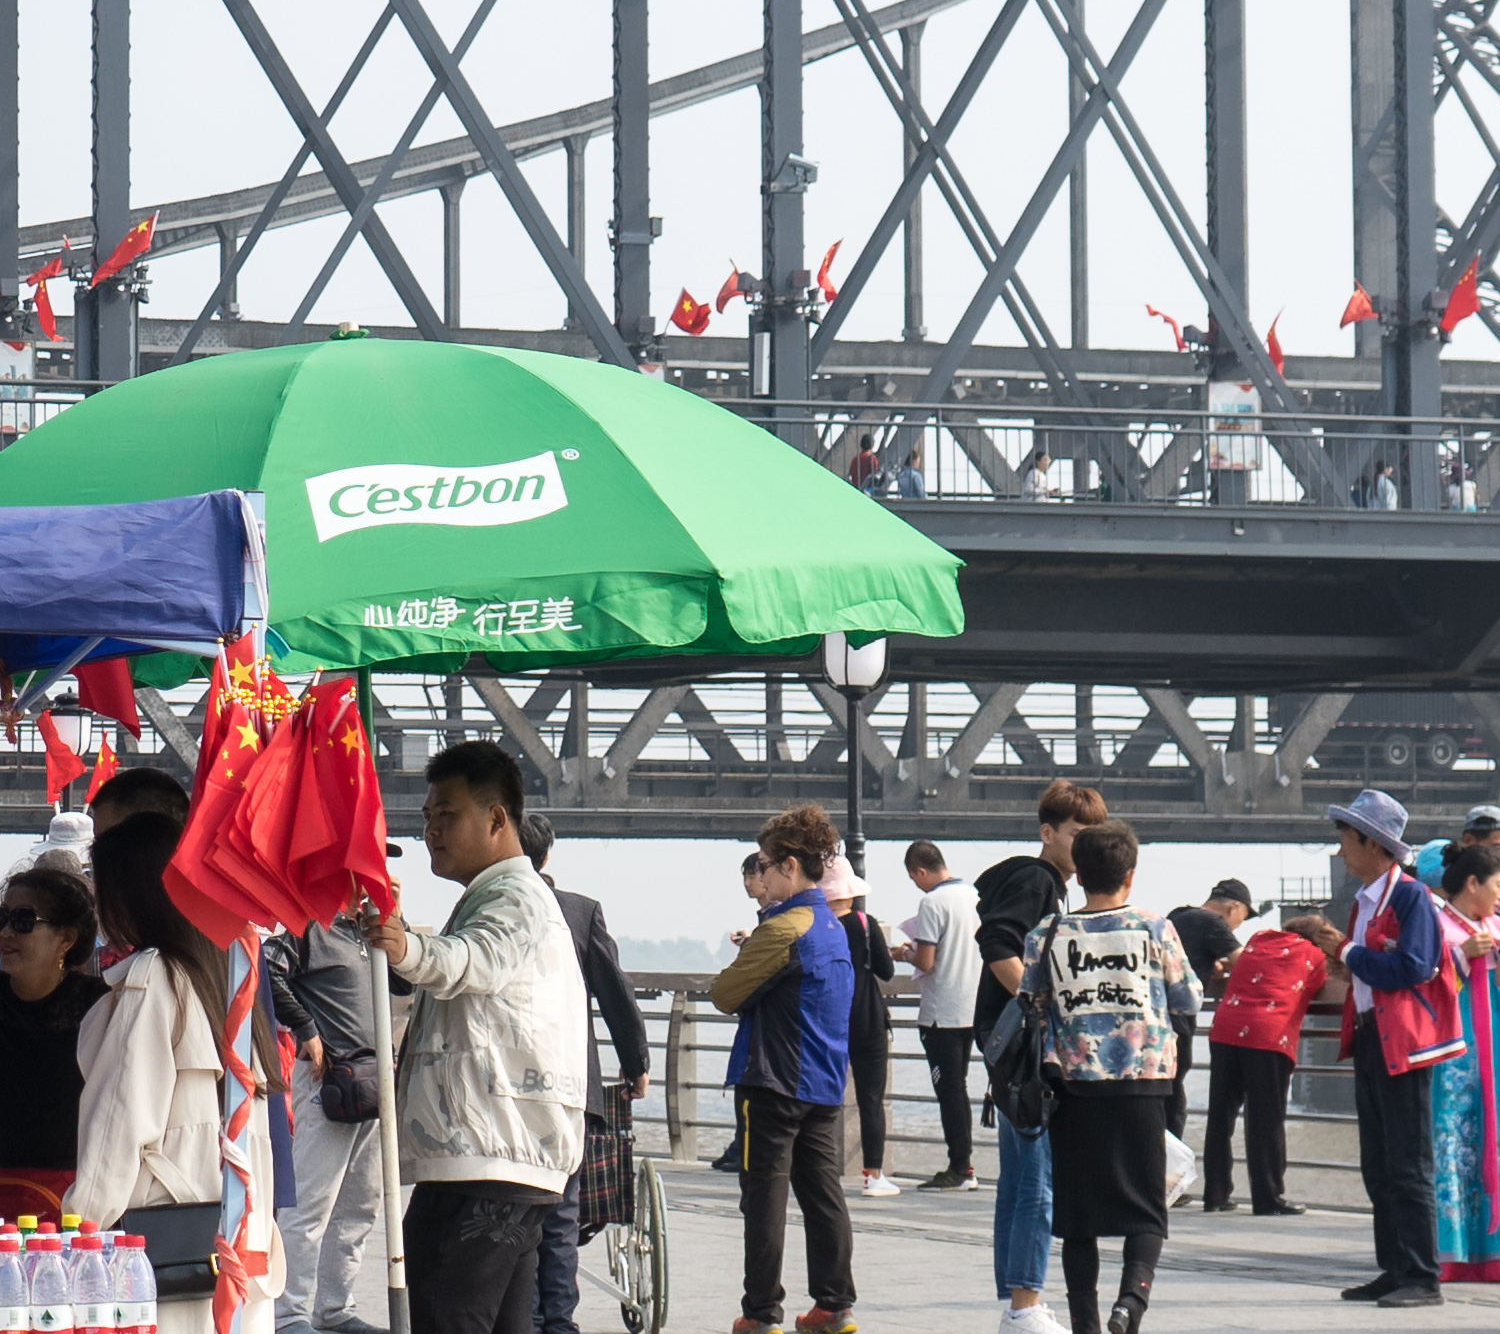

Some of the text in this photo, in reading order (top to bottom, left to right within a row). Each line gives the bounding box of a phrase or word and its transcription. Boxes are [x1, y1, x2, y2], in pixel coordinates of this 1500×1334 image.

[328, 474, 546, 518] C'estbon
[472, 595, 583, 637] 行至美
